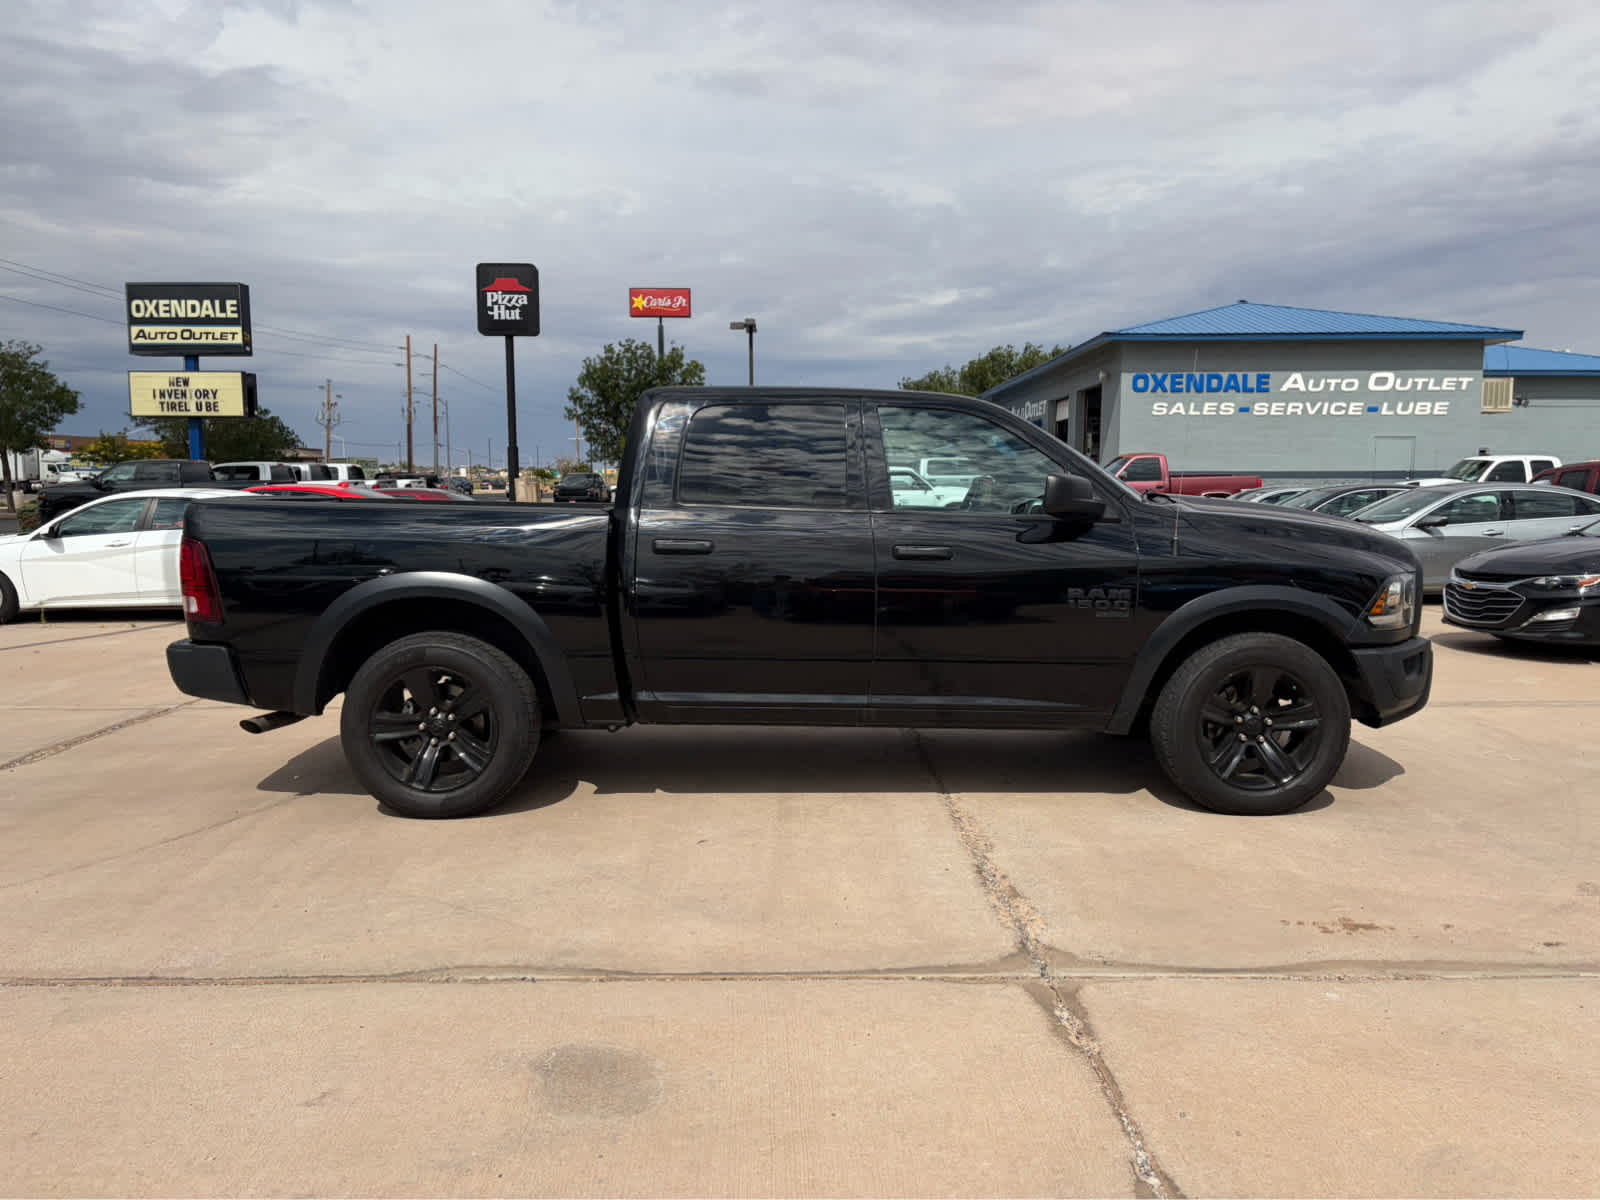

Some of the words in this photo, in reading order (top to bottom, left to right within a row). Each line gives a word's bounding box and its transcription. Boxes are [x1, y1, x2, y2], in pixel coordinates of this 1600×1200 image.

[486, 291, 528, 307] Pizza
[131, 299, 239, 318] OXENDALE
[488, 304, 521, 320] Hut
[134, 329, 178, 341] AUTO
[181, 329, 239, 341] OUTLET
[1132, 372, 1271, 394] OXENDALE
[1280, 372, 1360, 392] AUTO
[1367, 371, 1474, 392] OUTLET
[1067, 587, 1131, 599] RAM
